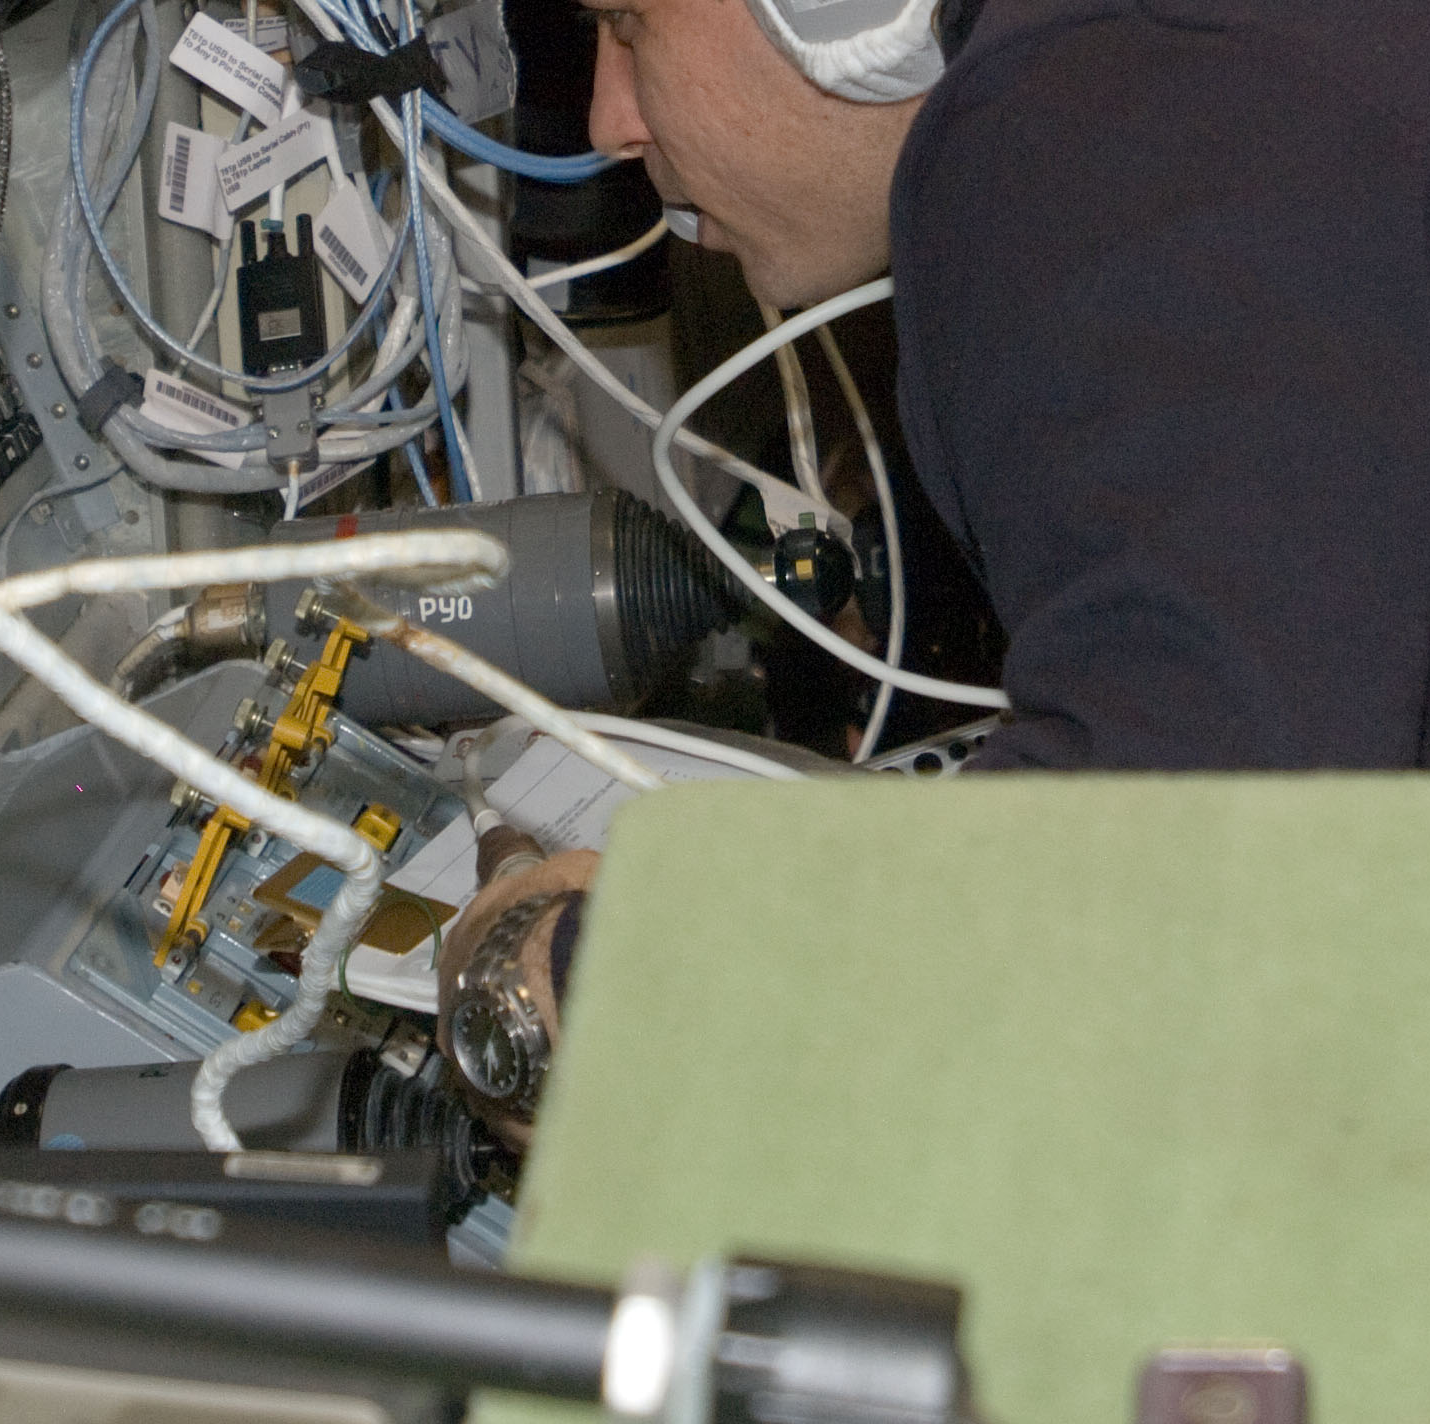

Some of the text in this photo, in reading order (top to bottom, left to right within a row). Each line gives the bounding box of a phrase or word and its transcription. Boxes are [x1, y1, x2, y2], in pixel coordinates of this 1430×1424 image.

[183, 36, 194, 49] To
[194, 45, 212, 61] Any
[219, 60, 234, 74] Pin
[233, 69, 258, 89] Serial
[209, 41, 228, 59] USB
[238, 60, 263, 80] Serial
[237, 154, 252, 168] USB
[225, 181, 241, 196] USB
